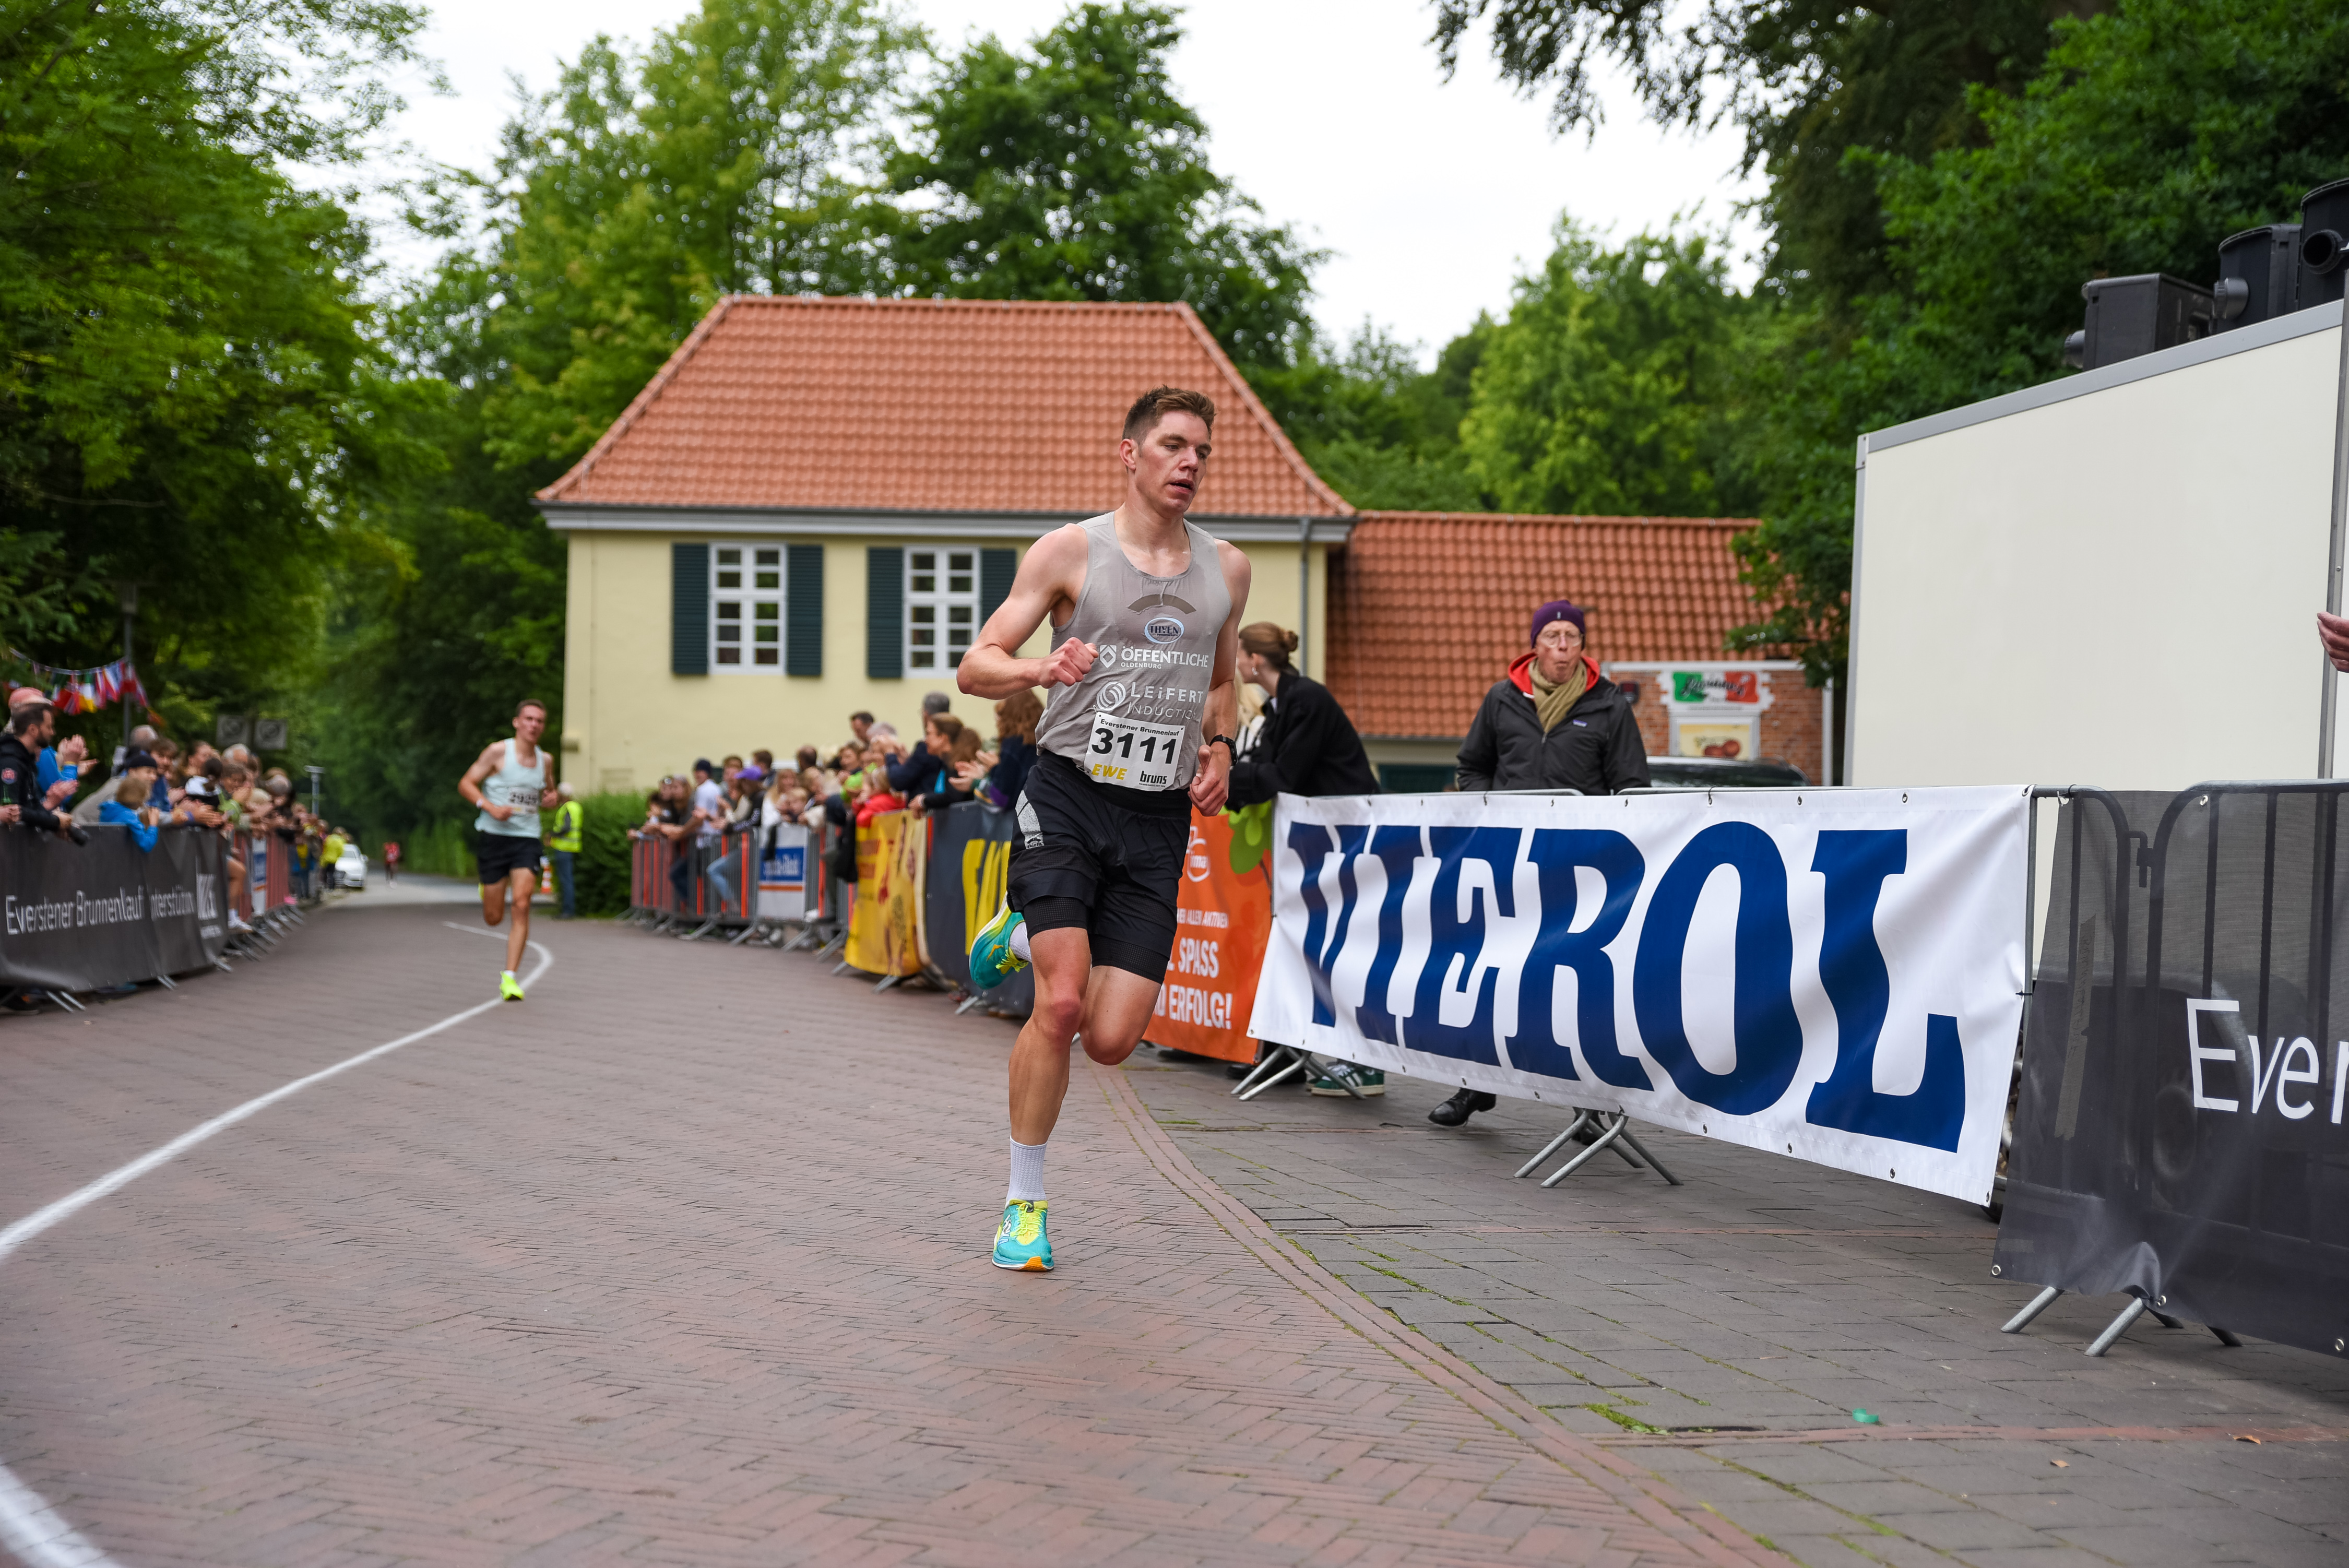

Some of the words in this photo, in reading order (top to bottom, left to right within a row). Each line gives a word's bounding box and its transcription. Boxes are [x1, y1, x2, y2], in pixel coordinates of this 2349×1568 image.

[1149, 625, 1179, 634] THYEN
[1121, 646, 1209, 668] ÖFFENTLICHE
[1100, 718, 1138, 731] Everstener
[1140, 727, 1180, 736] Brunnenlauf
[1092, 728, 1177, 764] 3111
[1091, 763, 1128, 780] EWE
[1140, 770, 1168, 785] bruns
[5, 895, 75, 935] Everstener
[76, 885, 144, 928] Brunnenlauf
[1178, 937, 1219, 979] SPASS
[1287, 821, 1966, 1154] VIEROL
[1169, 984, 1233, 1030] ERFOLG!
